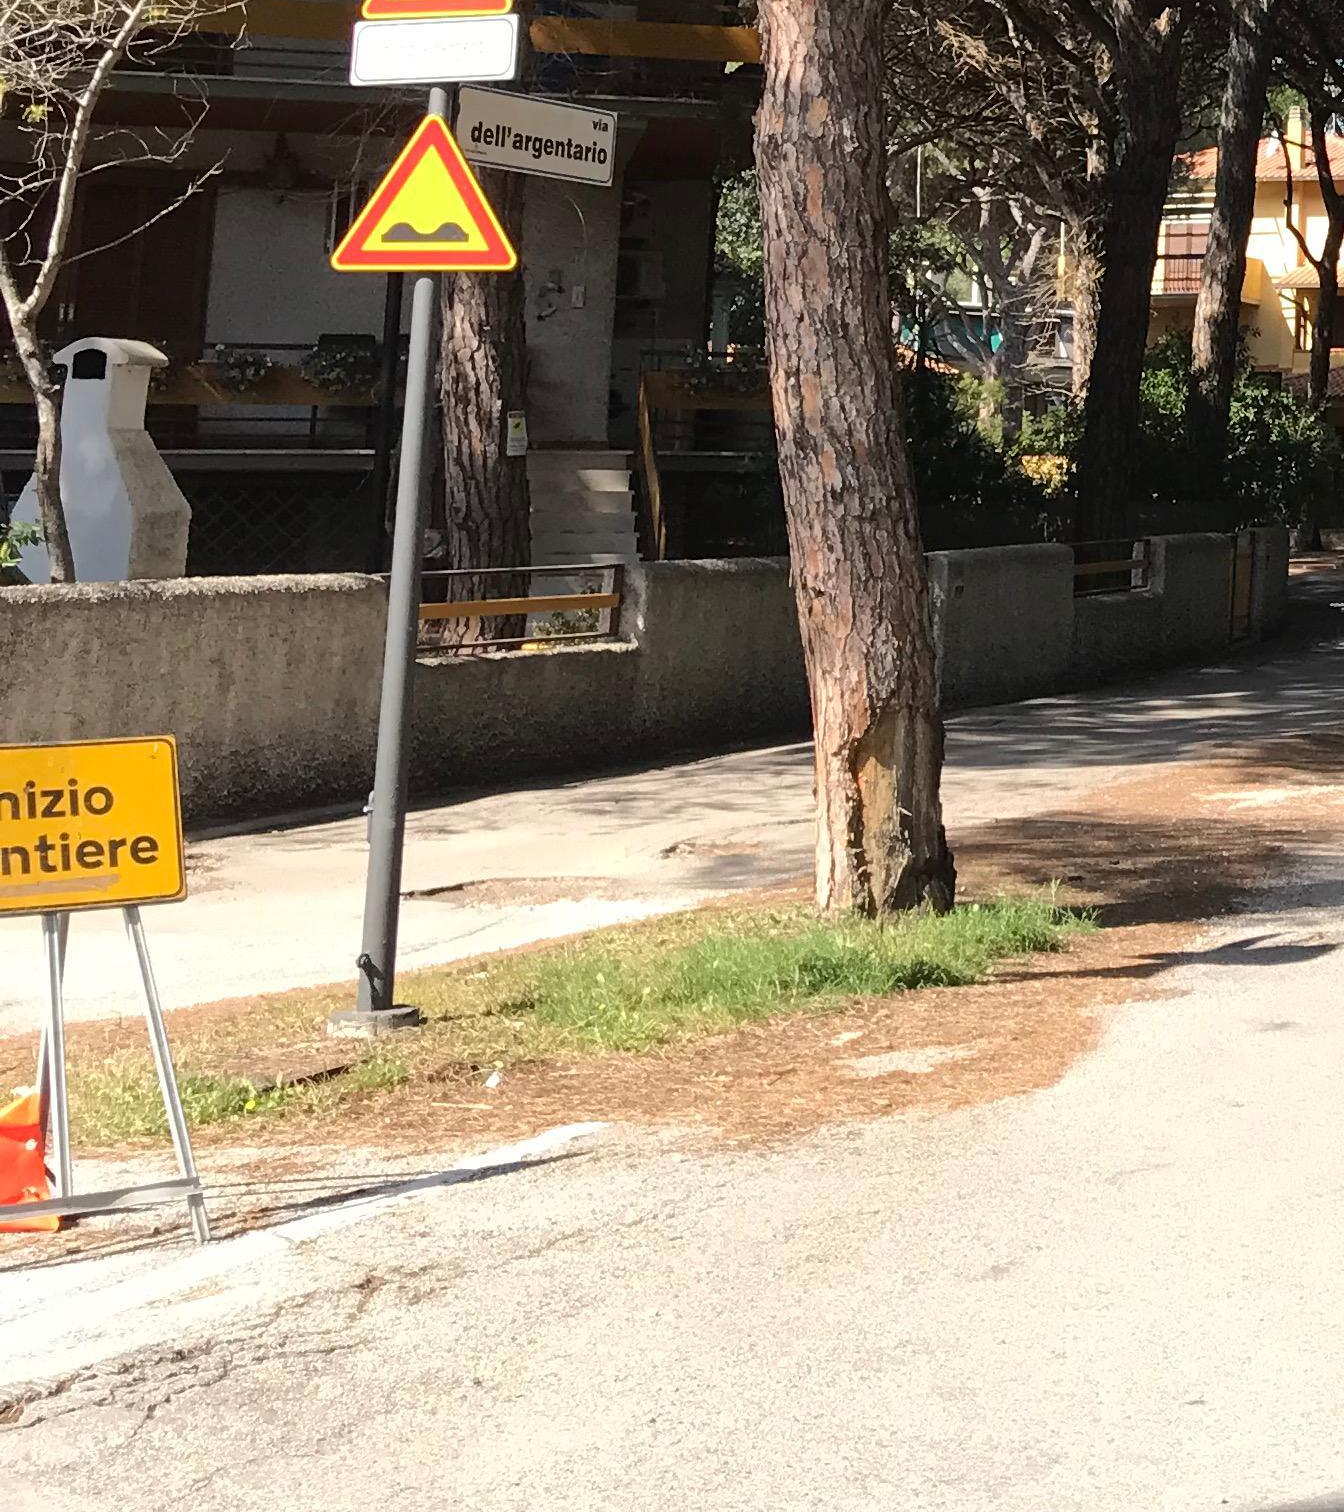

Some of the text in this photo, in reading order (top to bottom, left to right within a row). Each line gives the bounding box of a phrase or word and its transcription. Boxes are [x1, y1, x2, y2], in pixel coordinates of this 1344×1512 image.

[470, 121, 608, 165] dell'argentario
[592, 118, 609, 133] via
[0, 832, 159, 875] ntiere
